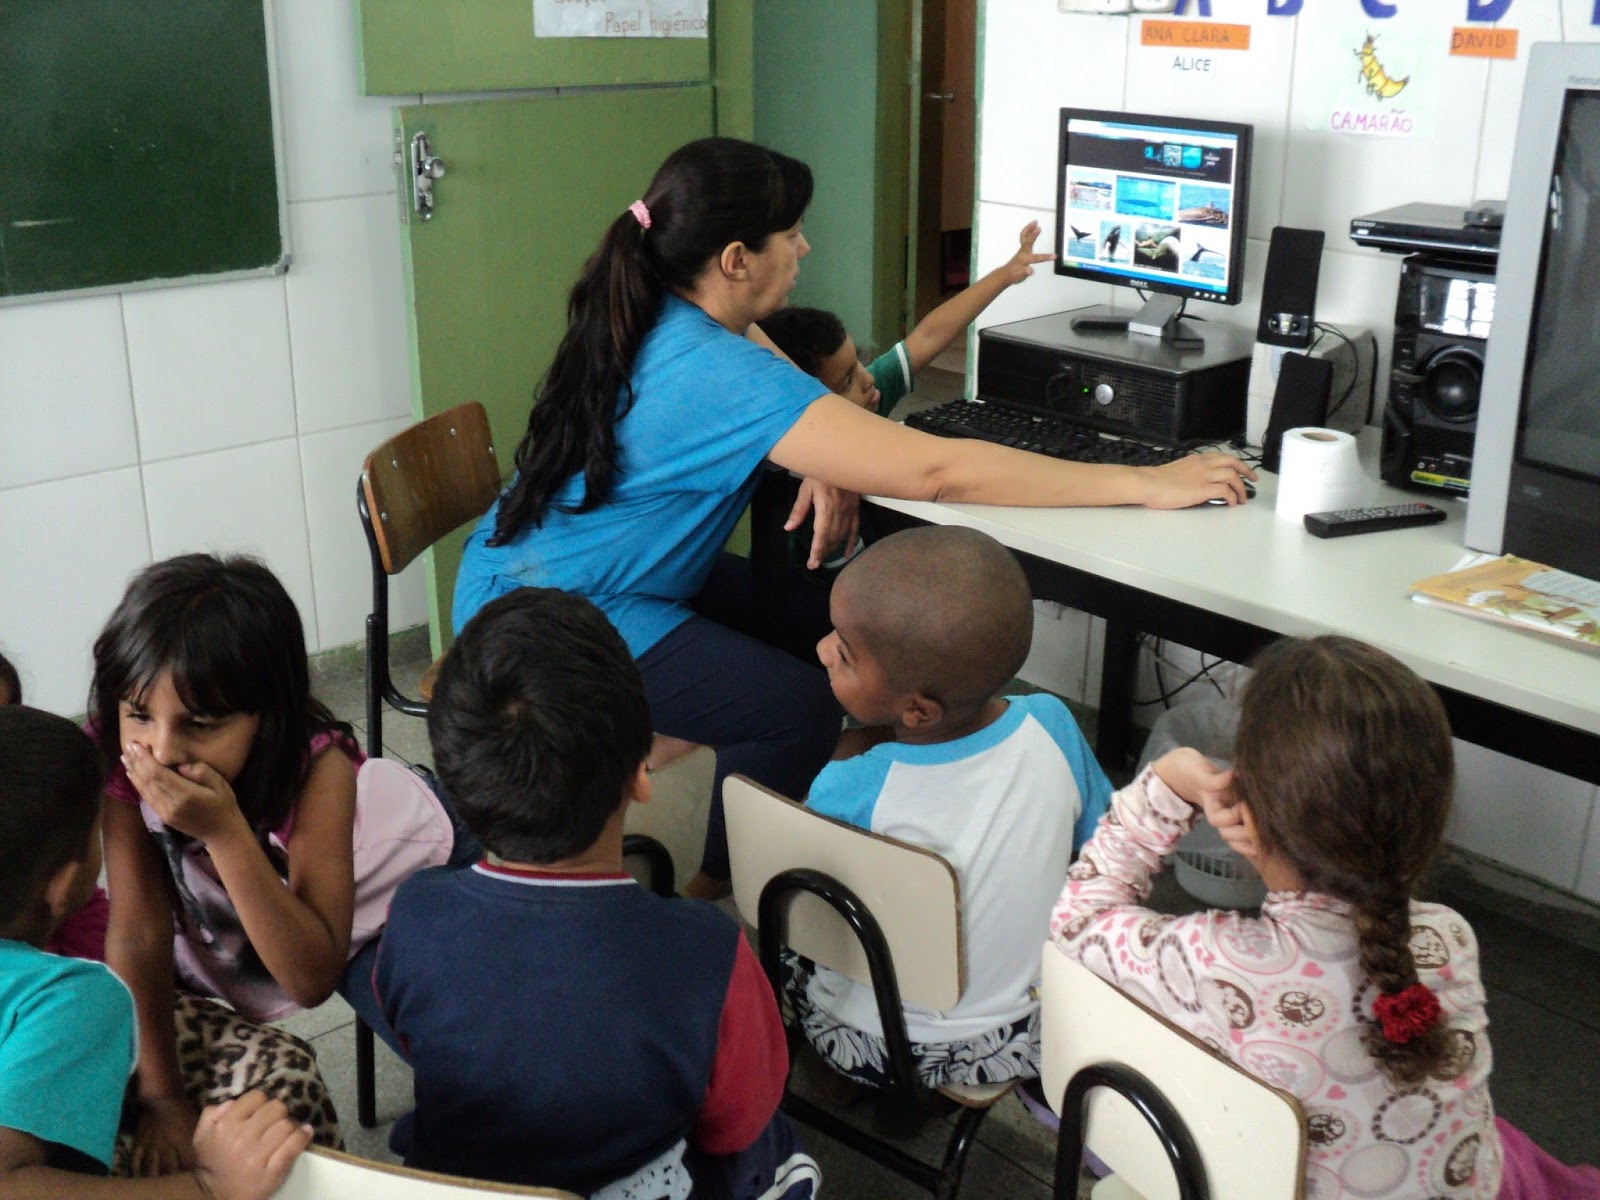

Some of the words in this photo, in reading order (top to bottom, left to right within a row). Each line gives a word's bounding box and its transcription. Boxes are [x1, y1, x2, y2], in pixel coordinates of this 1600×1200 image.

[604, 9, 641, 38] Papel
[650, 10, 706, 38] higiênico
[1145, 26, 1173, 41] ANA
[1183, 27, 1230, 42] CLARA
[1451, 32, 1506, 50] DAVID
[1173, 56, 1211, 71] ALICE
[1331, 108, 1413, 134] CAMARÃO
